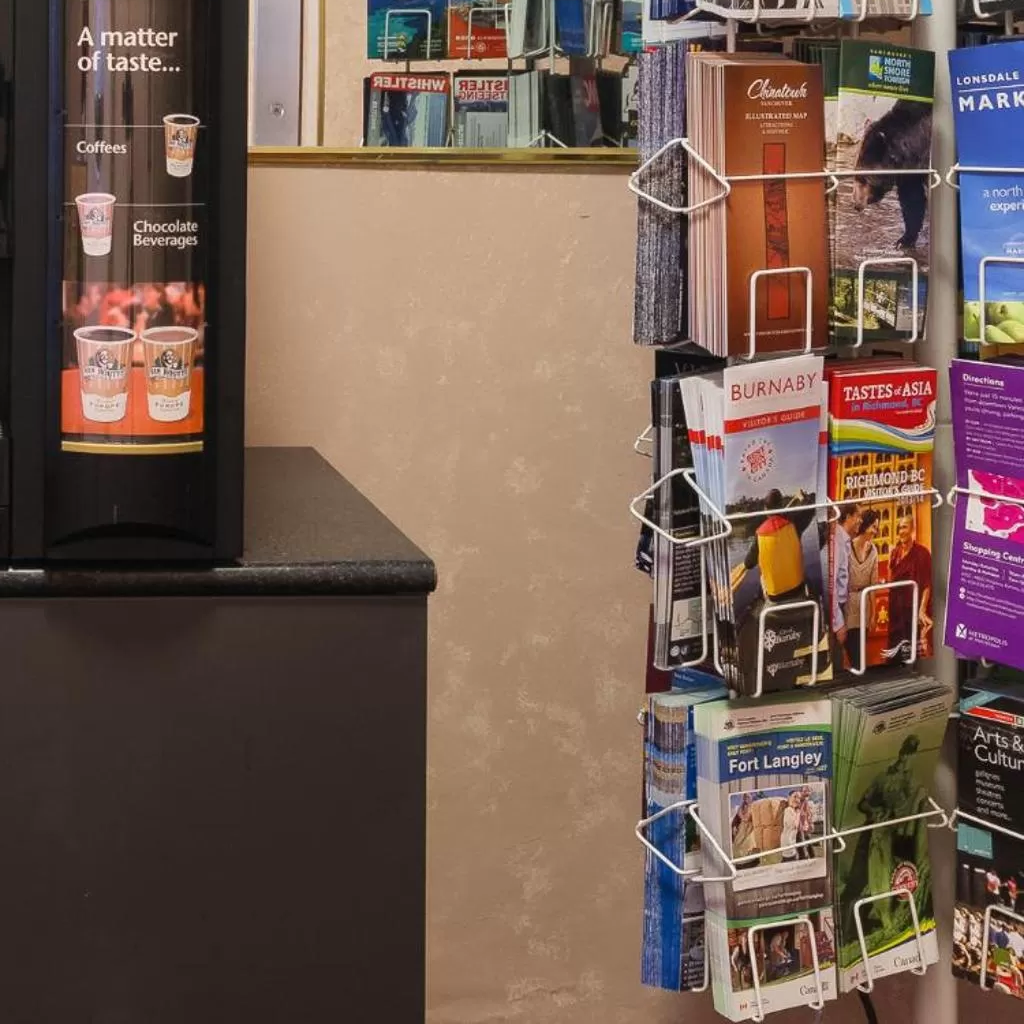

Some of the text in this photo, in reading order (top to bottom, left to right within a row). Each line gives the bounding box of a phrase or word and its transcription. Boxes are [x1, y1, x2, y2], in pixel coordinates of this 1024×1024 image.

[77, 27, 178, 47] A matter
[77, 51, 181, 72] of taste...
[884, 57, 912, 68] NORTH
[884, 66, 911, 77] SHORE
[957, 70, 1019, 86] LONSDALE
[747, 78, 808, 100] Chinatown
[793, 112, 808, 120] MAP
[77, 141, 127, 154] Coffees
[992, 185, 1023, 197] north
[133, 220, 198, 233] Chocolate
[133, 235, 198, 249] Beverages
[731, 372, 817, 401] BURNABY
[962, 373, 1004, 387] Directions
[843, 383, 893, 402] TASTES
[902, 381, 932, 397] ASIA
[780, 411, 805, 422] GUIDE
[846, 468, 926, 489] RICHMOND BC
[963, 541, 1001, 560] Shopping
[973, 726, 1024, 752] Arts &
[729, 751, 822, 773] Fort Langley
